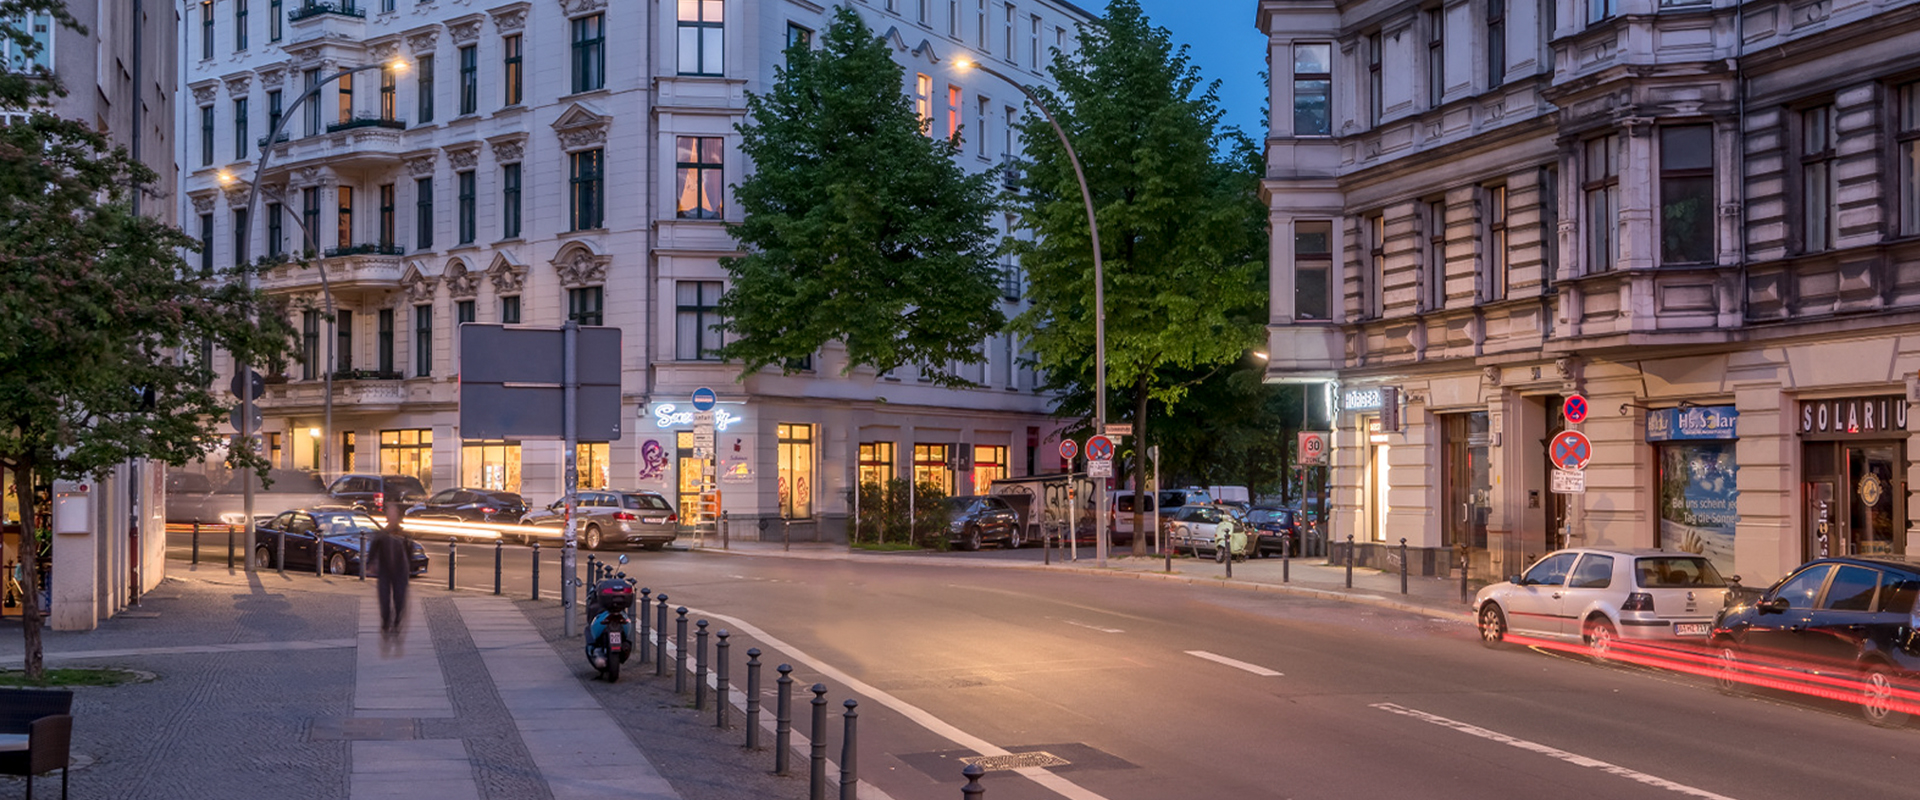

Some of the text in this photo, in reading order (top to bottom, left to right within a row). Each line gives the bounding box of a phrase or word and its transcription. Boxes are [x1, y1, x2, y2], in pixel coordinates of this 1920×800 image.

[1308, 440, 1320, 451] 30
[1672, 497, 1684, 509] Bei
[1685, 499, 1699, 509] uns
[1699, 497, 1726, 509] scheint
[1683, 511, 1697, 525] Tag
[1697, 512, 1710, 523] die
